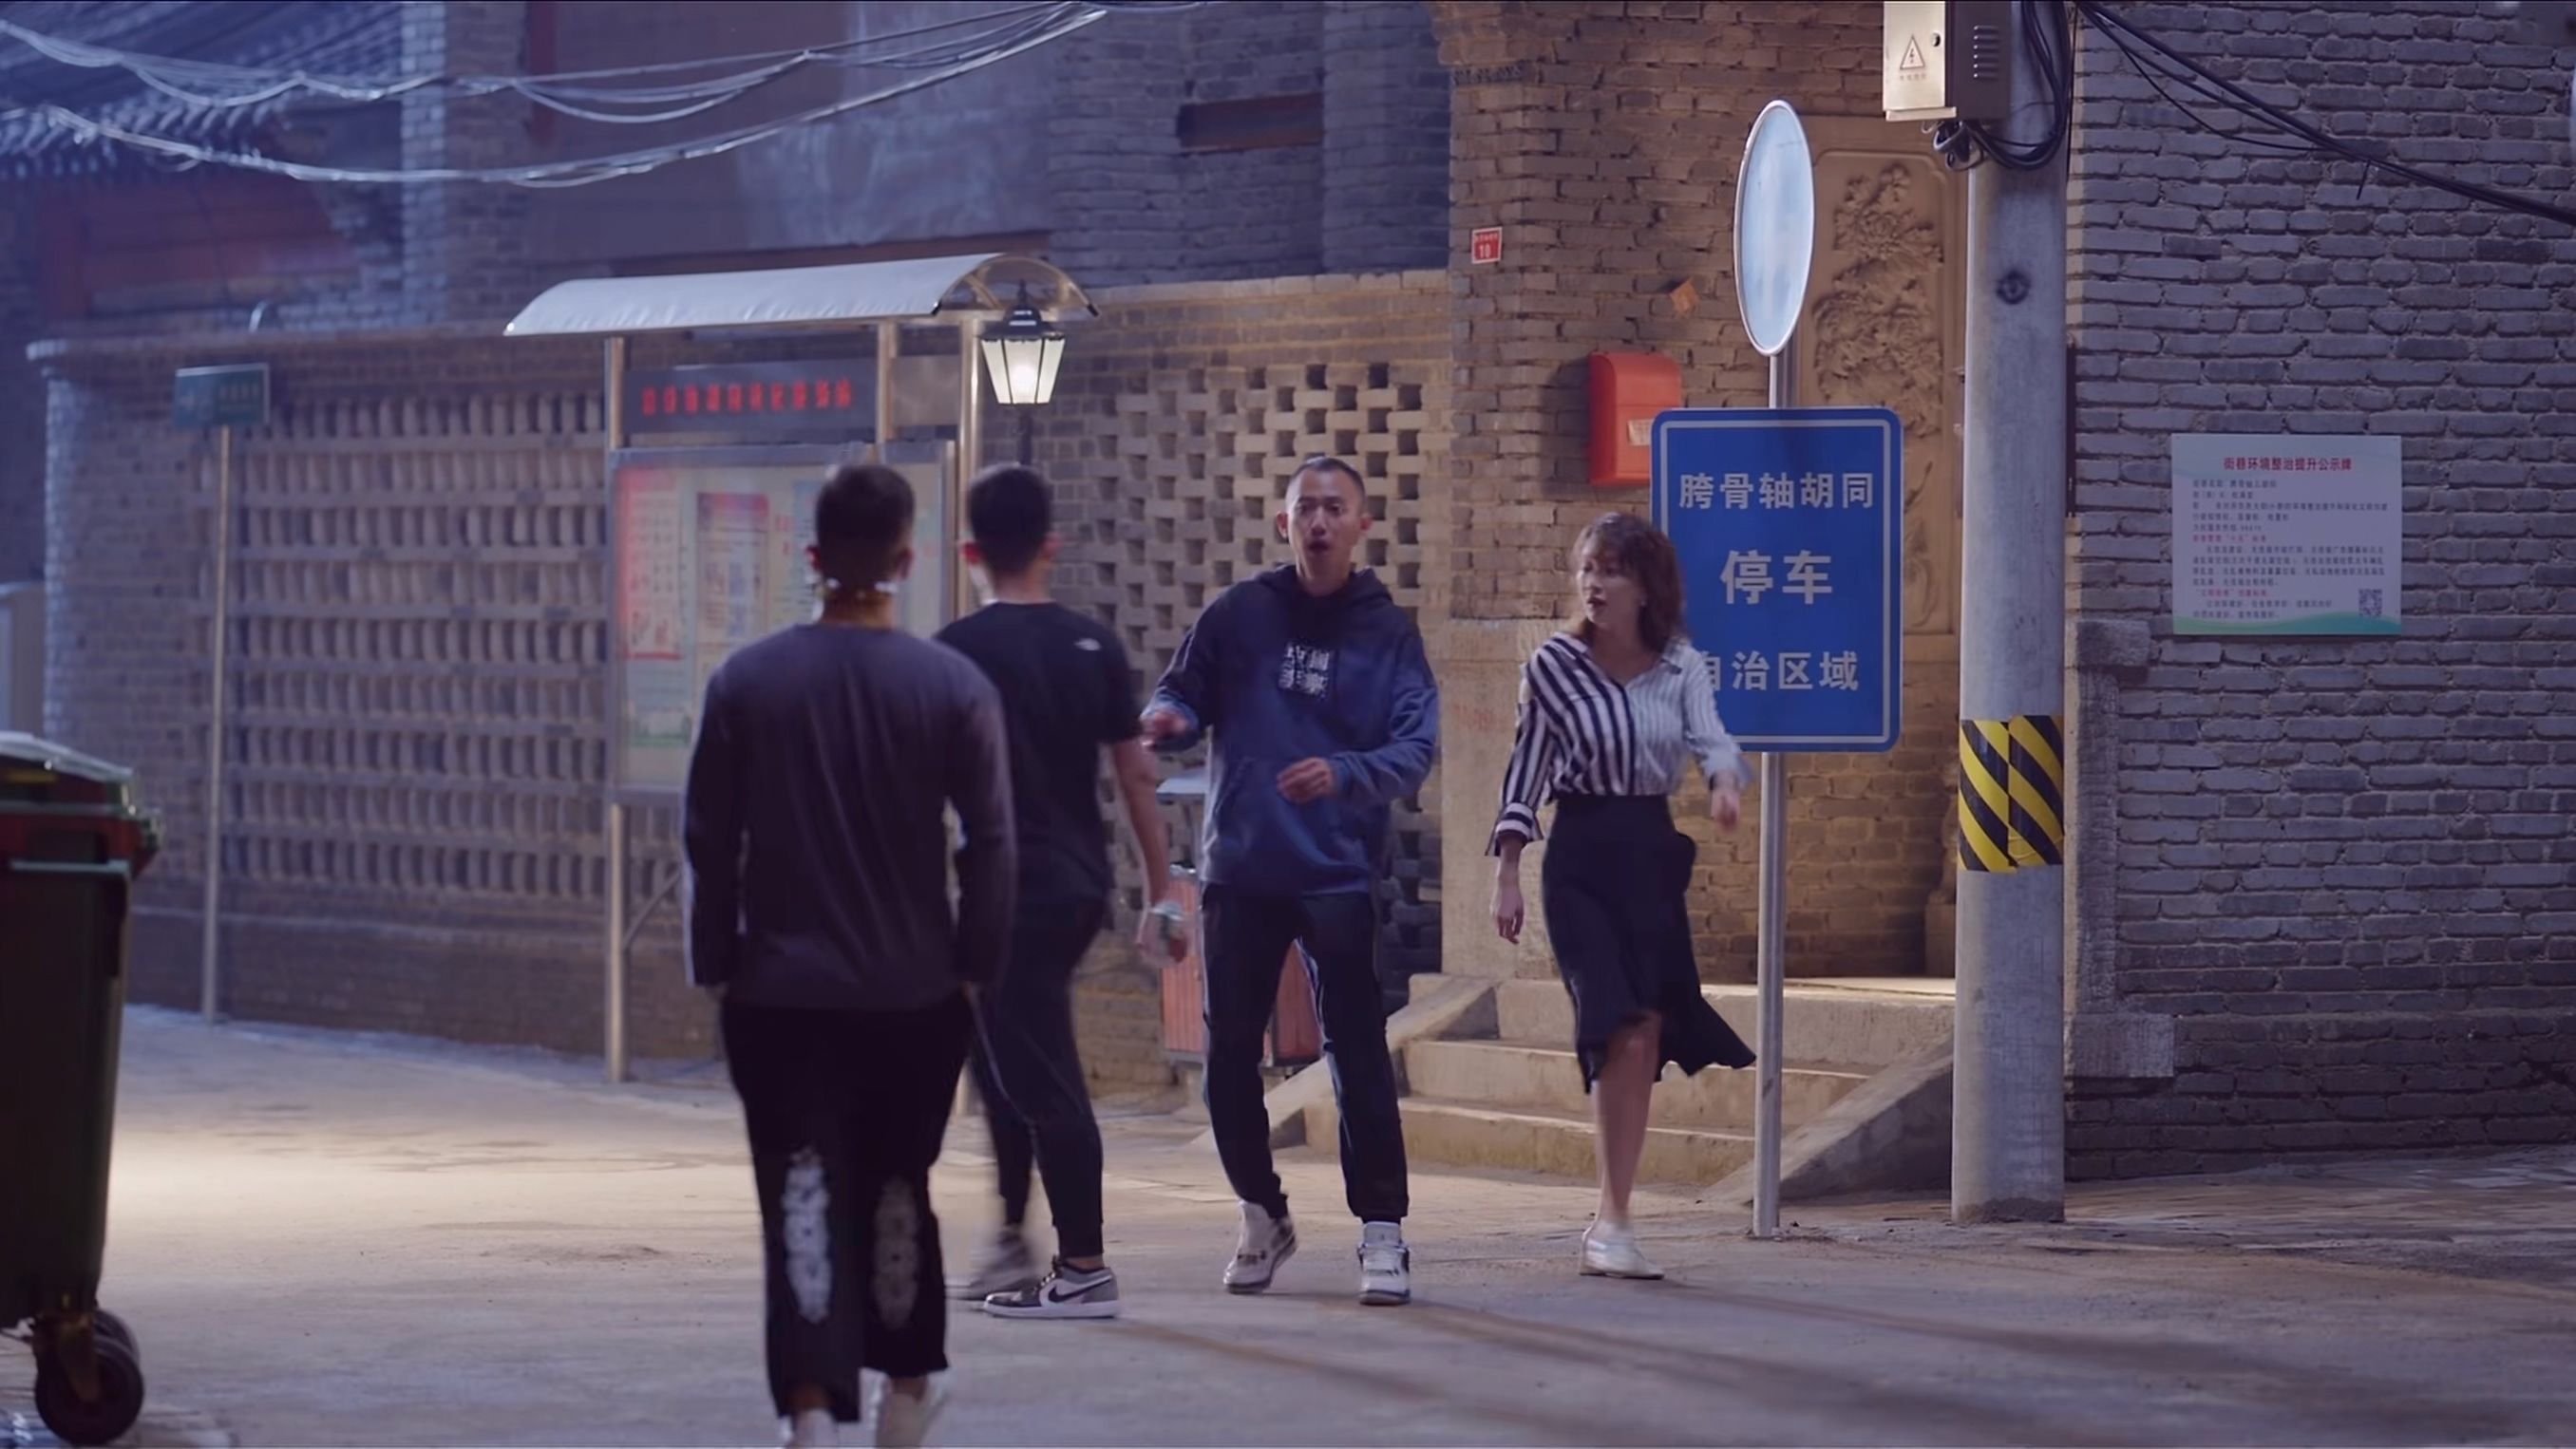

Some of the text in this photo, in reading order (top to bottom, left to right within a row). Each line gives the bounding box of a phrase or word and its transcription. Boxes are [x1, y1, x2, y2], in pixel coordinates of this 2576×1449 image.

[1679, 472, 1873, 510] 胯骨轴胡同
[1720, 550, 1833, 605] 停车
